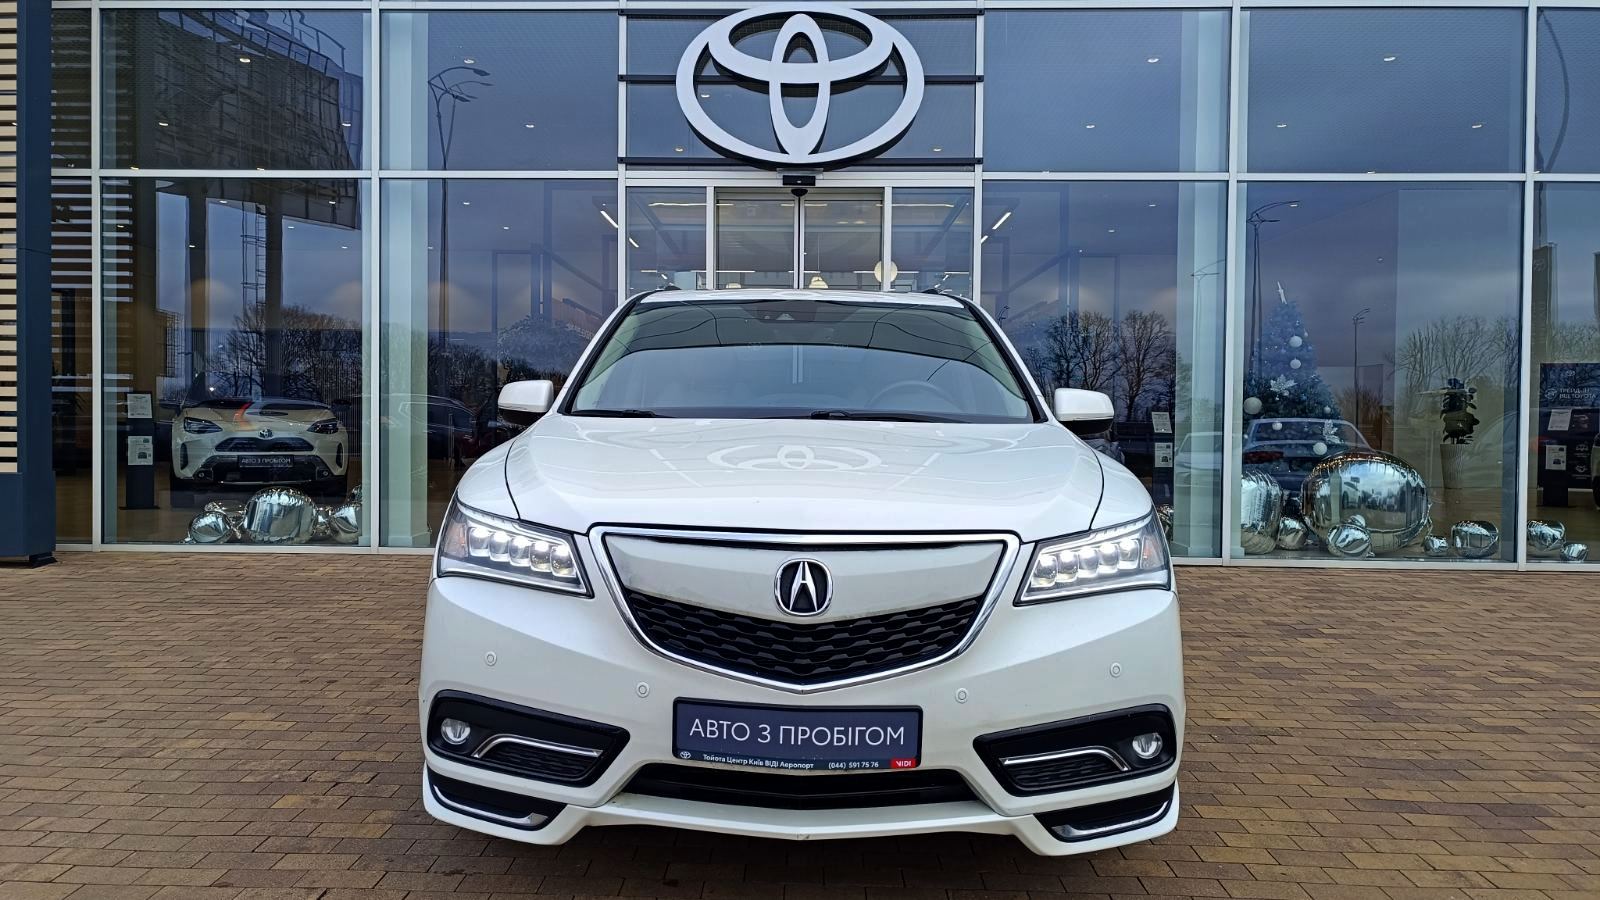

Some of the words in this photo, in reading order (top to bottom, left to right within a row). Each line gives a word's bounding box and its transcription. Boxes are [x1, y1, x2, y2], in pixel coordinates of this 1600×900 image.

[689, 718, 750, 741] АВТО
[757, 724, 771, 743] З
[779, 725, 905, 746] ПРОБІГОМ
[703, 753, 726, 763] Тойота
[726, 756, 748, 767] Центр
[749, 758, 764, 767] Київ
[764, 760, 779, 768] ВІДІ
[780, 761, 815, 770] Аеропорт
[828, 762, 847, 770] (044)
[848, 761, 860, 769] 591
[895, 760, 912, 768] VIDI
